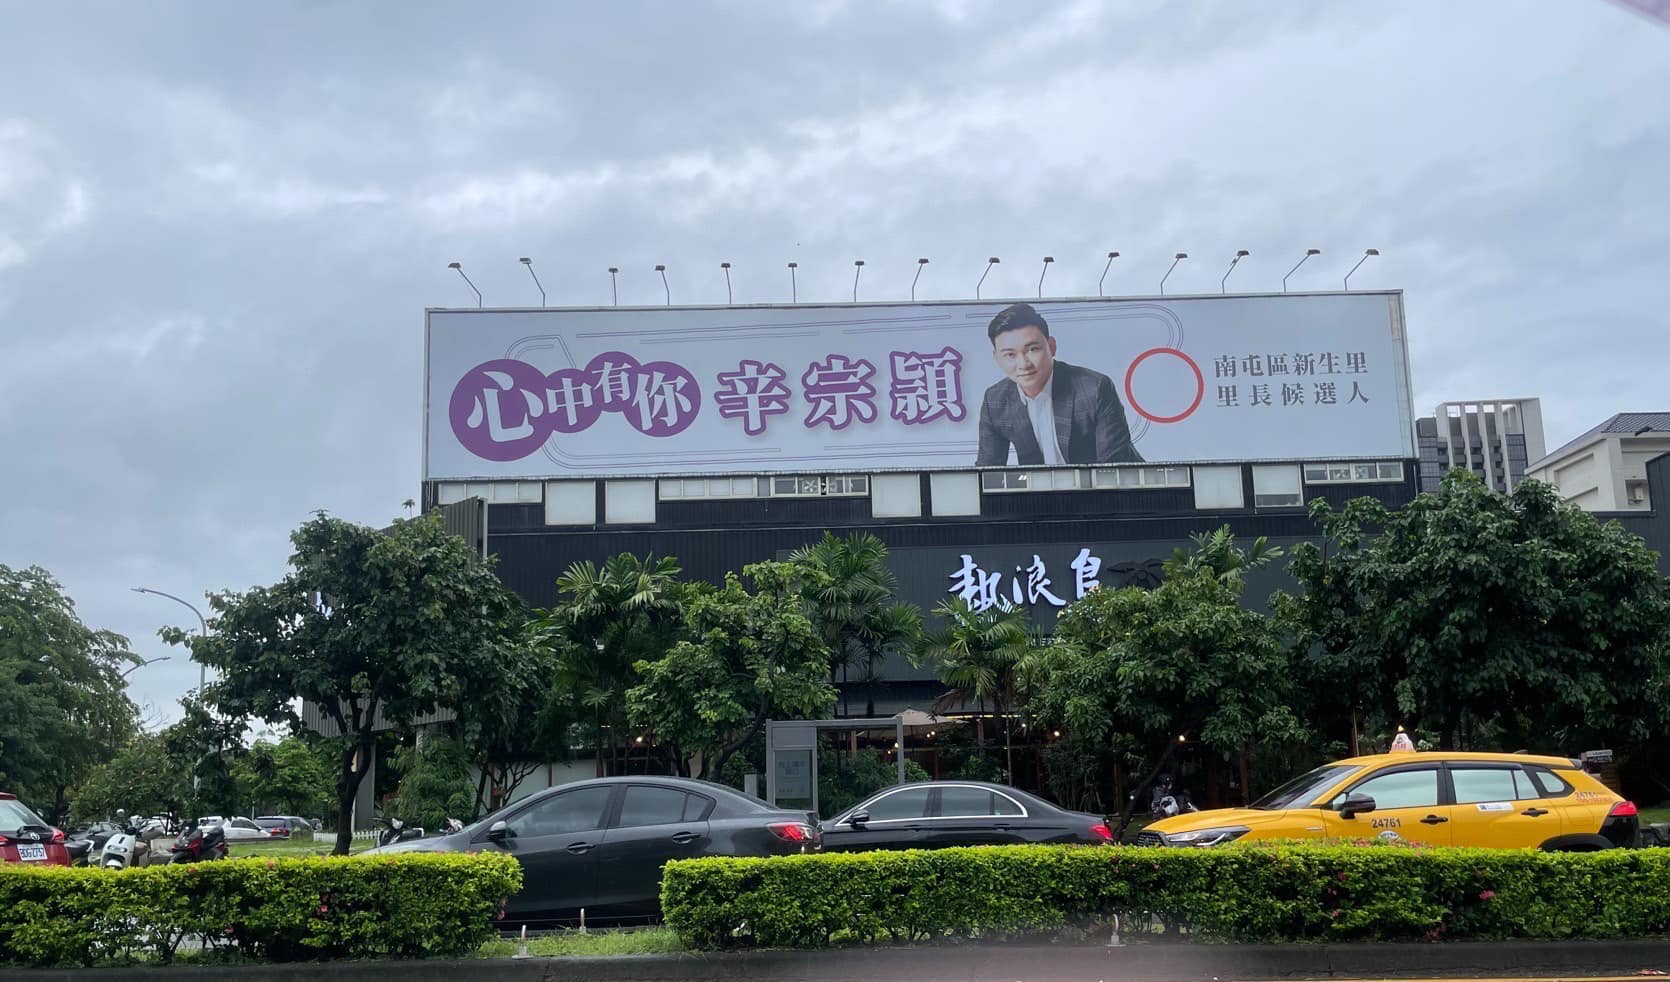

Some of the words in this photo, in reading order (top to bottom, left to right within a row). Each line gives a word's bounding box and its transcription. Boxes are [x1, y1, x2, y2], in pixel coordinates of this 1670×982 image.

[1214, 352, 1368, 378] 南屯區新生里
[466, 361, 692, 443] 心中有你
[1216, 381, 1369, 407] 里長候選人
[1371, 817, 1401, 829] 24761
